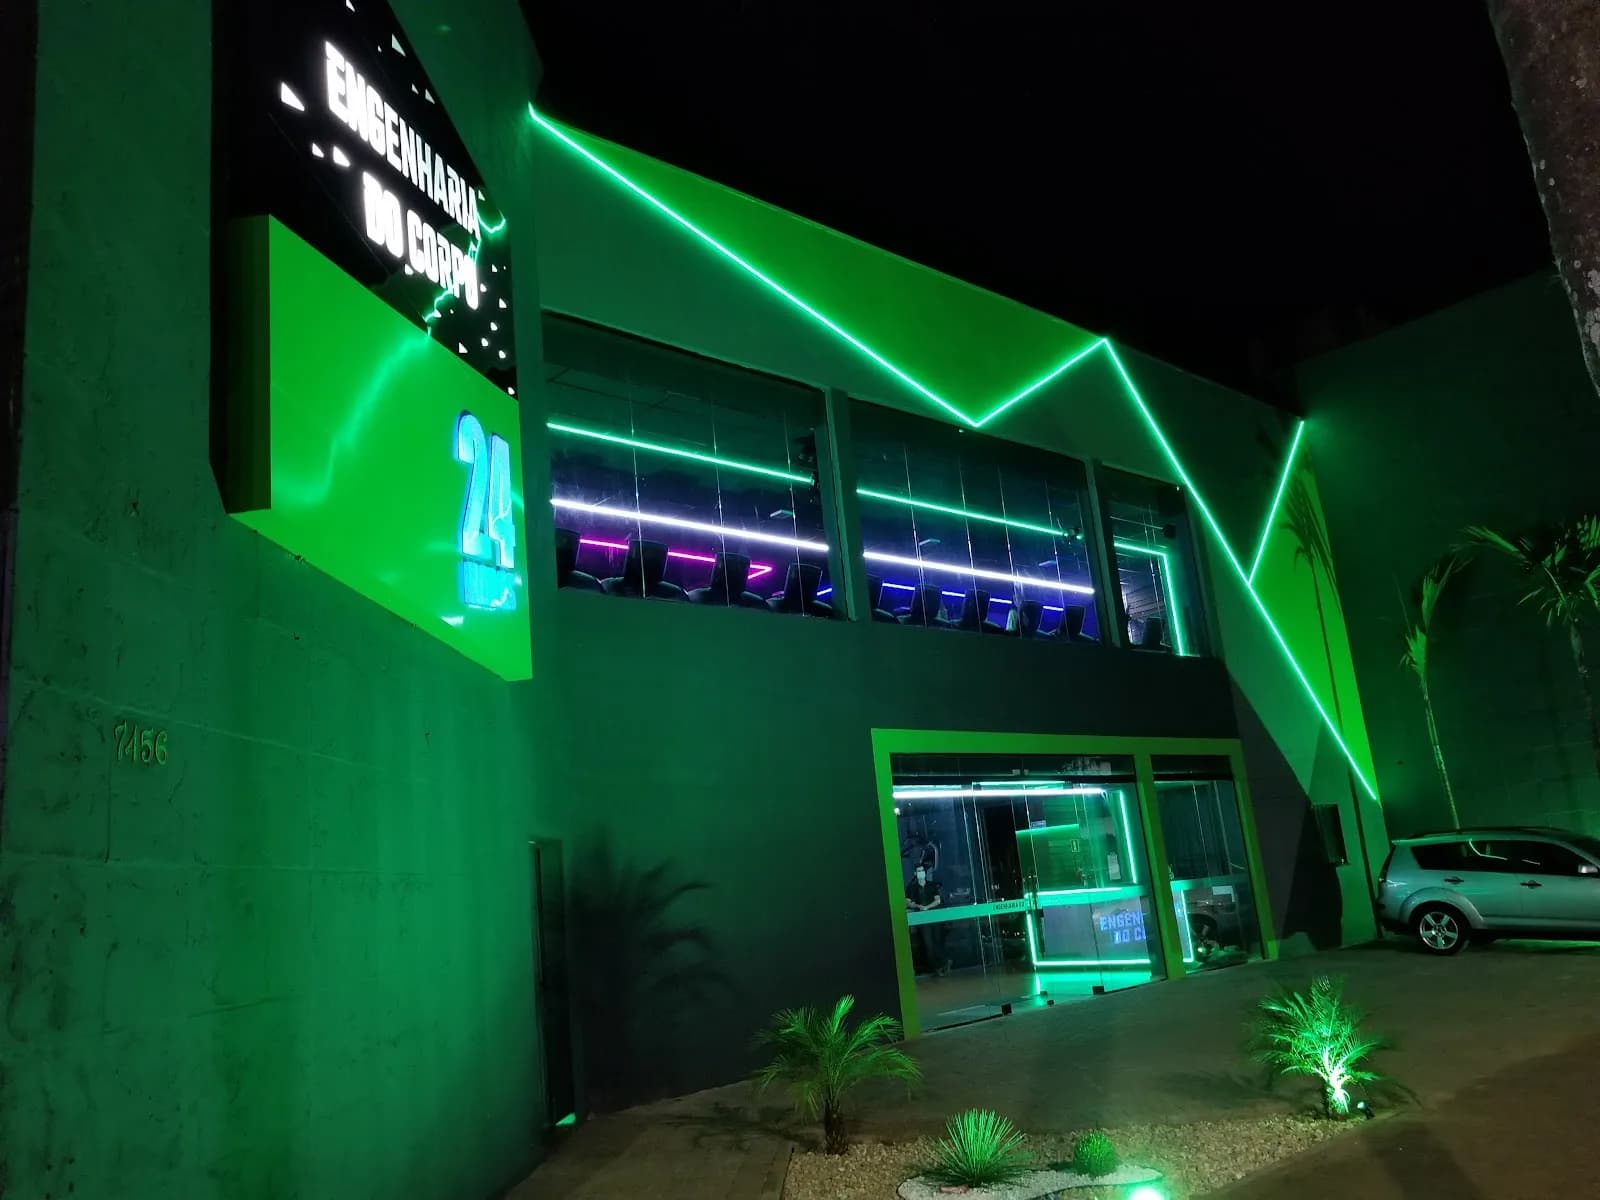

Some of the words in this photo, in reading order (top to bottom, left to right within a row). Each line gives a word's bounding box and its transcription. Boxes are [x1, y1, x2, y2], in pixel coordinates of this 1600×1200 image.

[324, 40, 482, 241] ENGENHARIA
[362, 170, 404, 259] DO
[406, 208, 480, 311] CORPO
[456, 410, 516, 570] 24
[113, 720, 168, 766] 7456
